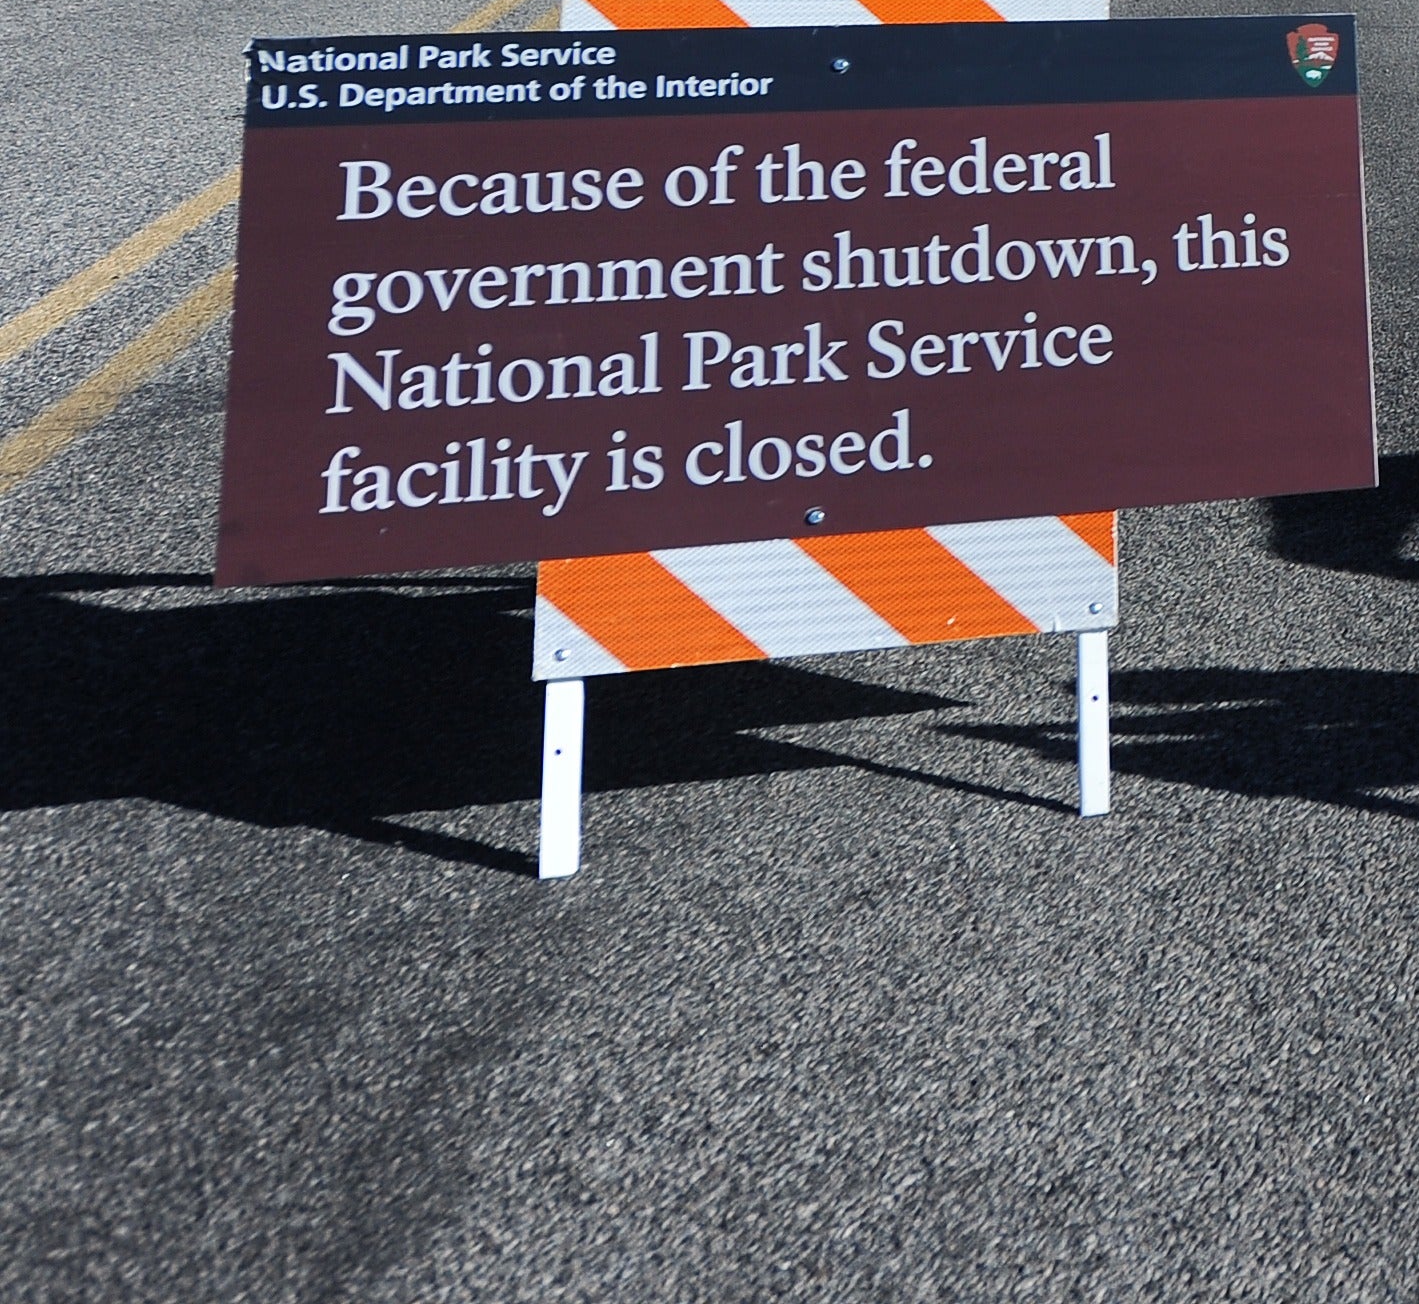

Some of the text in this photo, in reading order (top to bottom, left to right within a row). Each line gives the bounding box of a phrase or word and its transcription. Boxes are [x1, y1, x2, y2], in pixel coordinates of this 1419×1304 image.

[257, 42, 616, 73] National Park Service
[261, 72, 774, 112] U.S. Department of the Interior
[336, 132, 1116, 221] Because of the federal
[327, 213, 1290, 337] government shutdown, this
[325, 311, 1114, 414] National Park Service
[318, 408, 933, 517] facility is closed.
